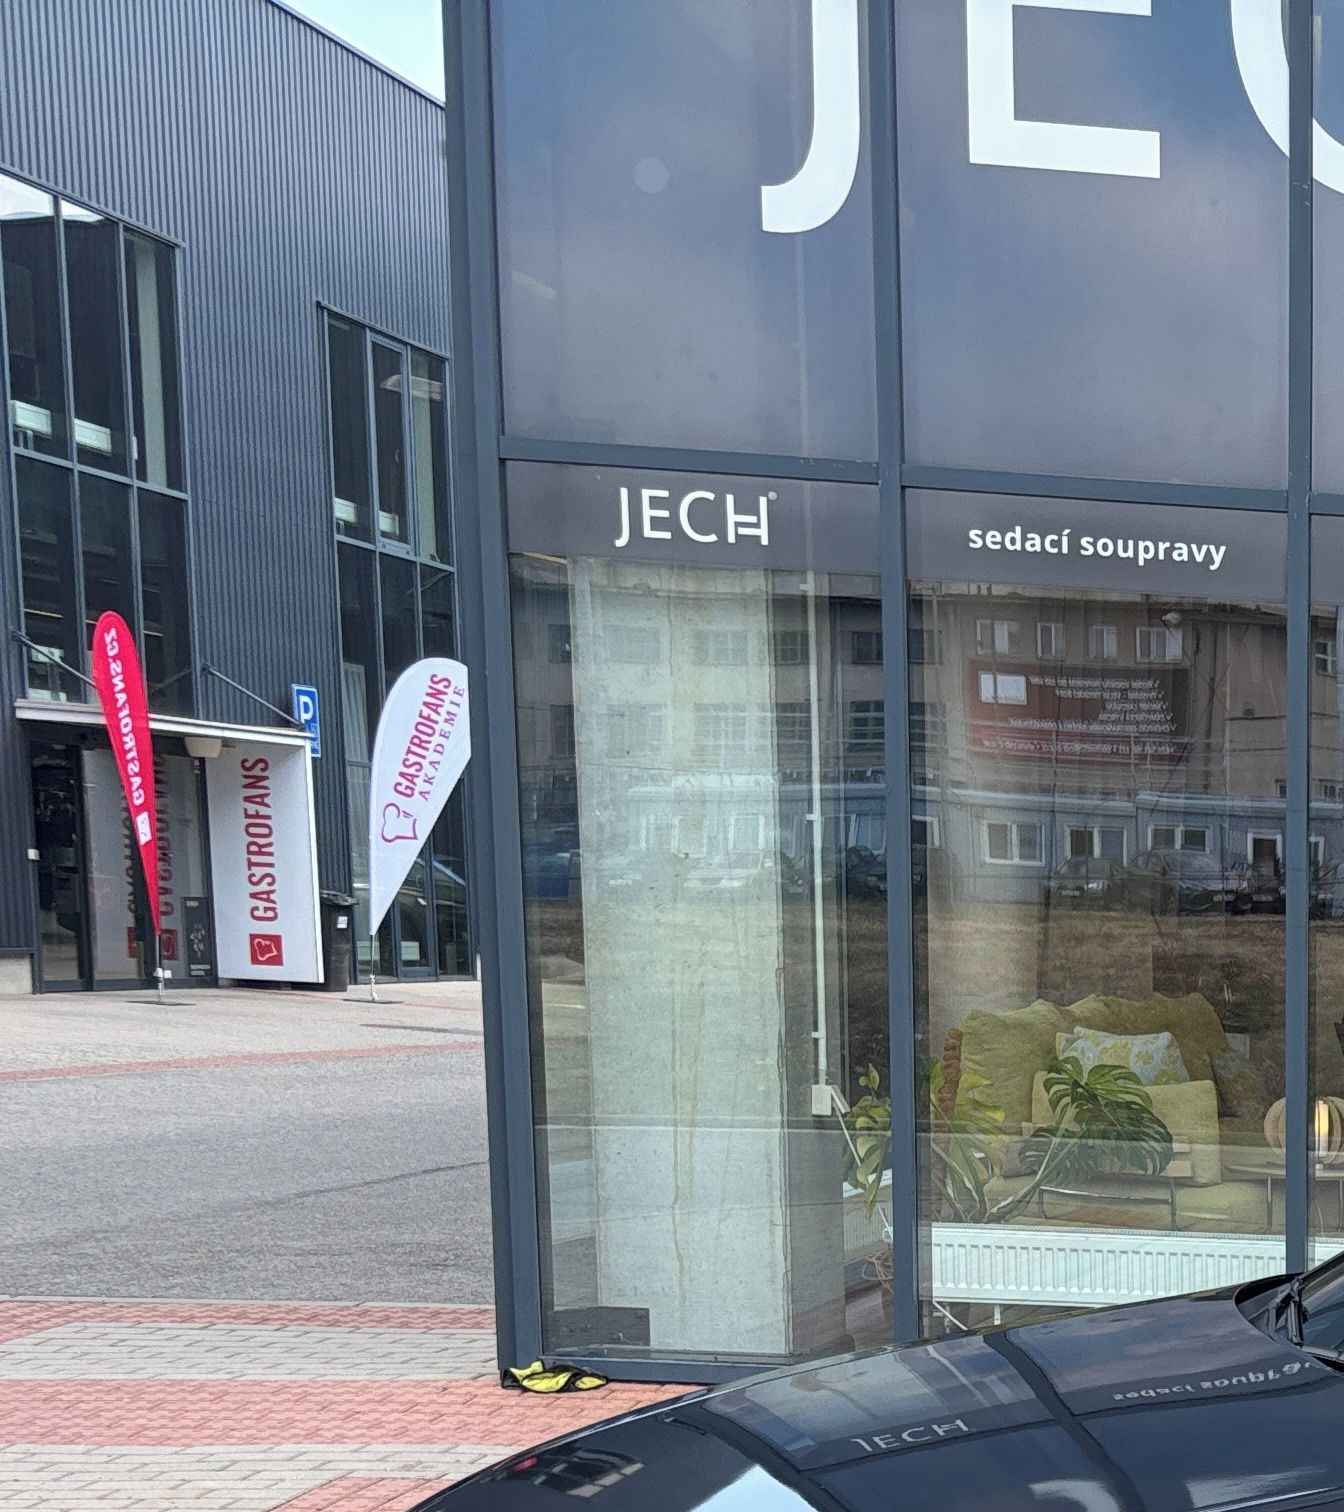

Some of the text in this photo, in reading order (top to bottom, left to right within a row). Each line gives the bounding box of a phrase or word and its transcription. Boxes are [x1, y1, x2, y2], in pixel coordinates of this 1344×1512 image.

[968, 525, 1227, 571] sedací soupravy
[393, 673, 452, 800] GASTROFANS
[418, 685, 465, 802] AKADEMIE
[240, 757, 279, 923] GASTROFANS
